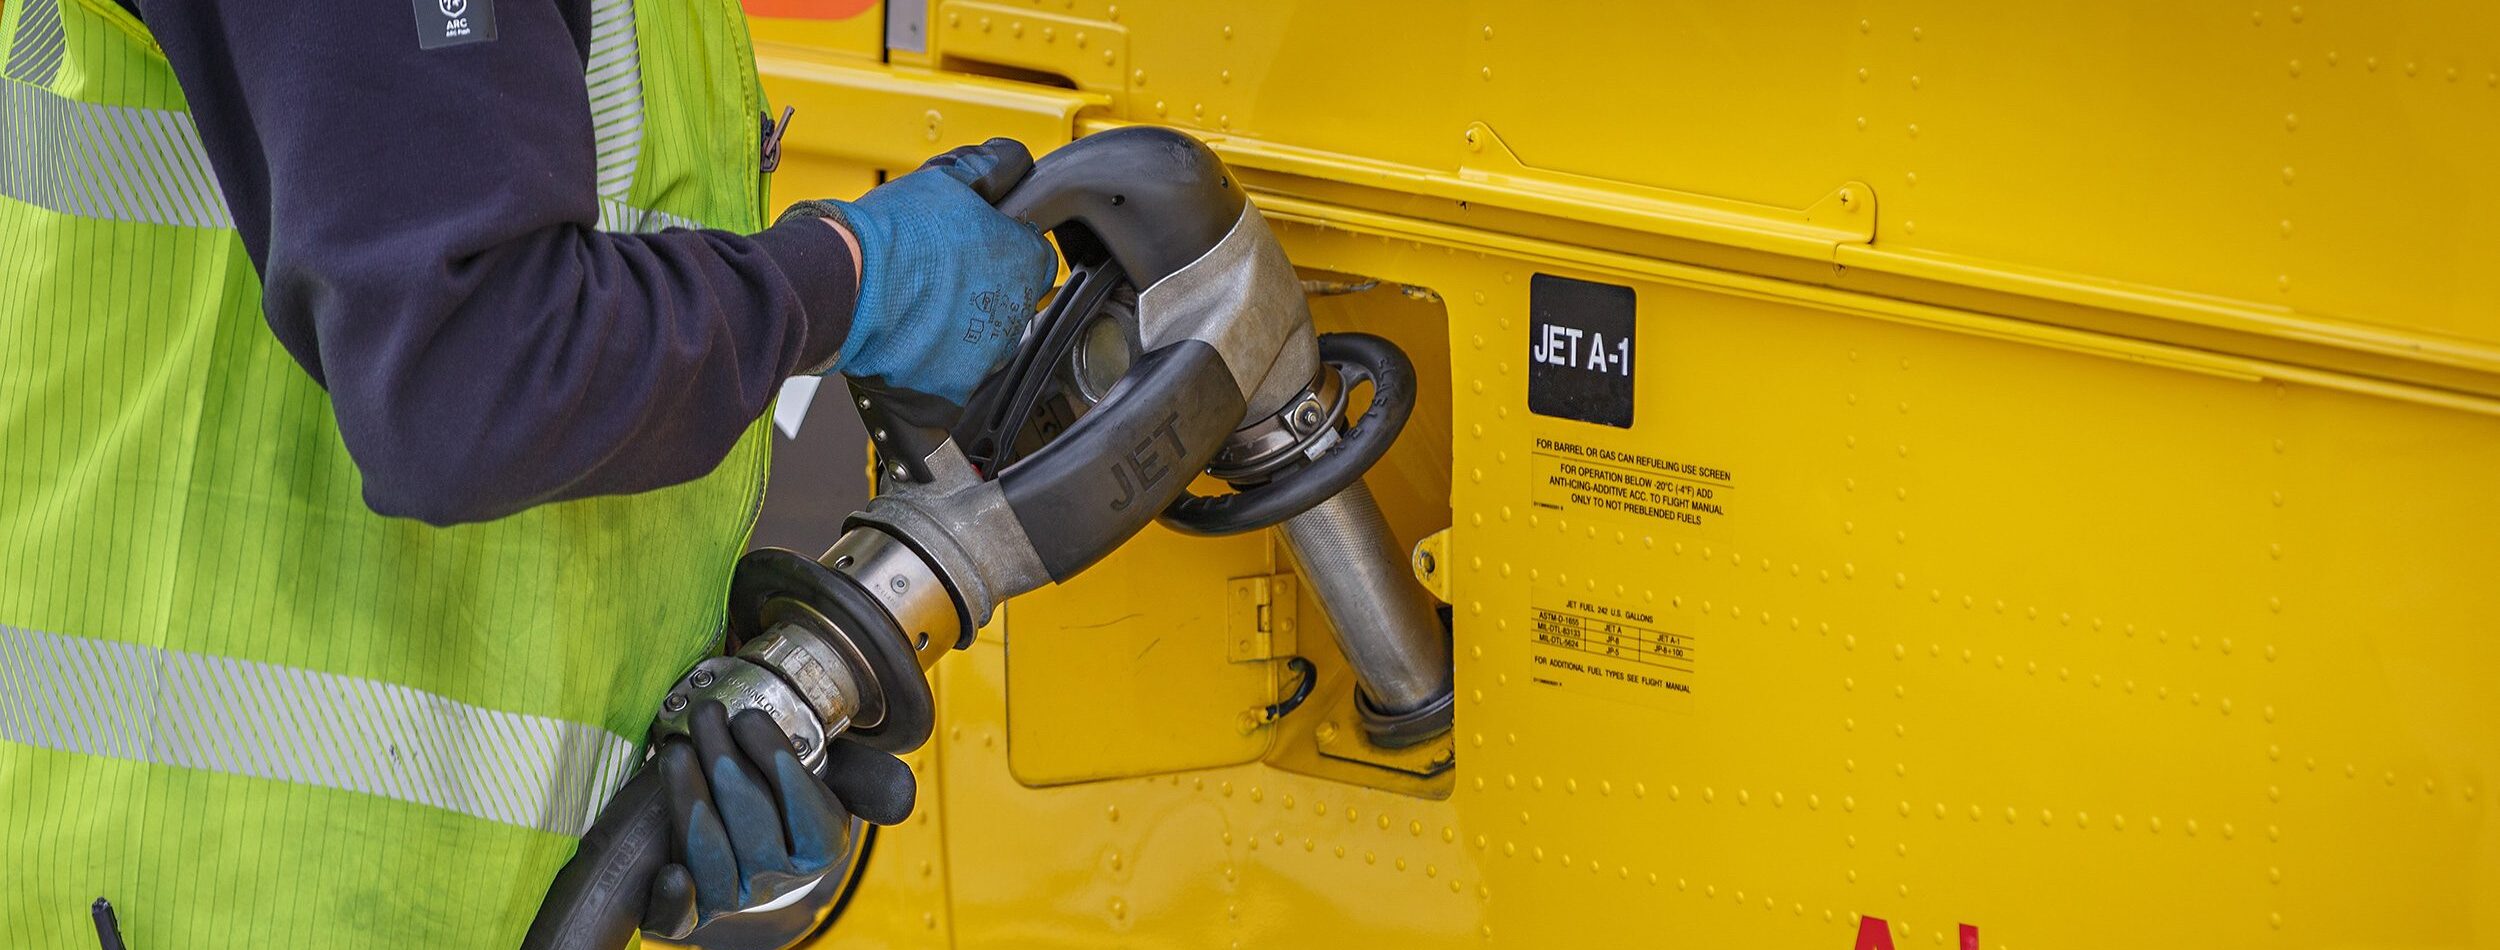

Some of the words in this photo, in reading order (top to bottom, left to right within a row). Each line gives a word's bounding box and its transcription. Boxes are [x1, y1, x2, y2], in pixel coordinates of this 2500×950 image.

[447, 18, 467, 30] ARC
[1534, 323, 1582, 368] JET
[1587, 332, 1629, 376] A-1
[1110, 411, 1187, 512] JET
[1536, 438, 1552, 450] FOR
[1554, 441, 1584, 456] BARREL
[1586, 447, 1598, 458] OR
[1600, 449, 1616, 461] GAS
[1618, 452, 1634, 464] CAN
[1636, 455, 1680, 472] REFUELING
[1681, 463, 1697, 475] USE
[1699, 467, 1731, 481] SCREEN
[1549, 476, 1627, 498] ANTI-ICING-ADDITIVE
[1630, 490, 1648, 502] ACC.
[1650, 493, 1661, 503] TO
[1662, 495, 1690, 509] FLIGHT
[1692, 501, 1724, 515] MANUAL
[1560, 463, 1577, 475] FOR
[1578, 466, 1623, 483] OPERATION
[1625, 474, 1652, 488] BELOW
[1654, 481, 1674, 492] -20°C
[1675, 483, 1695, 497] (-4°F)
[1696, 488, 1713, 499] ADD
[1571, 493, 1591, 505] ONLY
[1594, 497, 1604, 507] TO
[1606, 500, 1623, 510] NOT
[1624, 502, 1675, 520] PREBLENDED
[1677, 512, 1701, 525] FUELS
[1566, 600, 1577, 609] JET
[1580, 601, 1595, 613] FUEL
[1626, 611, 1654, 624] GALLONS
[1604, 624, 1616, 633] JET
[1618, 626, 1622, 635] A
[1657, 634, 1668, 643] JET
[1534, 655, 1547, 665] FOR
[1549, 658, 1584, 673] ADDITIONAL
[1587, 666, 1602, 677] FUEL
[1605, 669, 1624, 681] TYPES
[1627, 673, 1639, 684] SEE
[1642, 677, 1663, 688] FLIGHT
[1666, 681, 1691, 694] MANUAL
